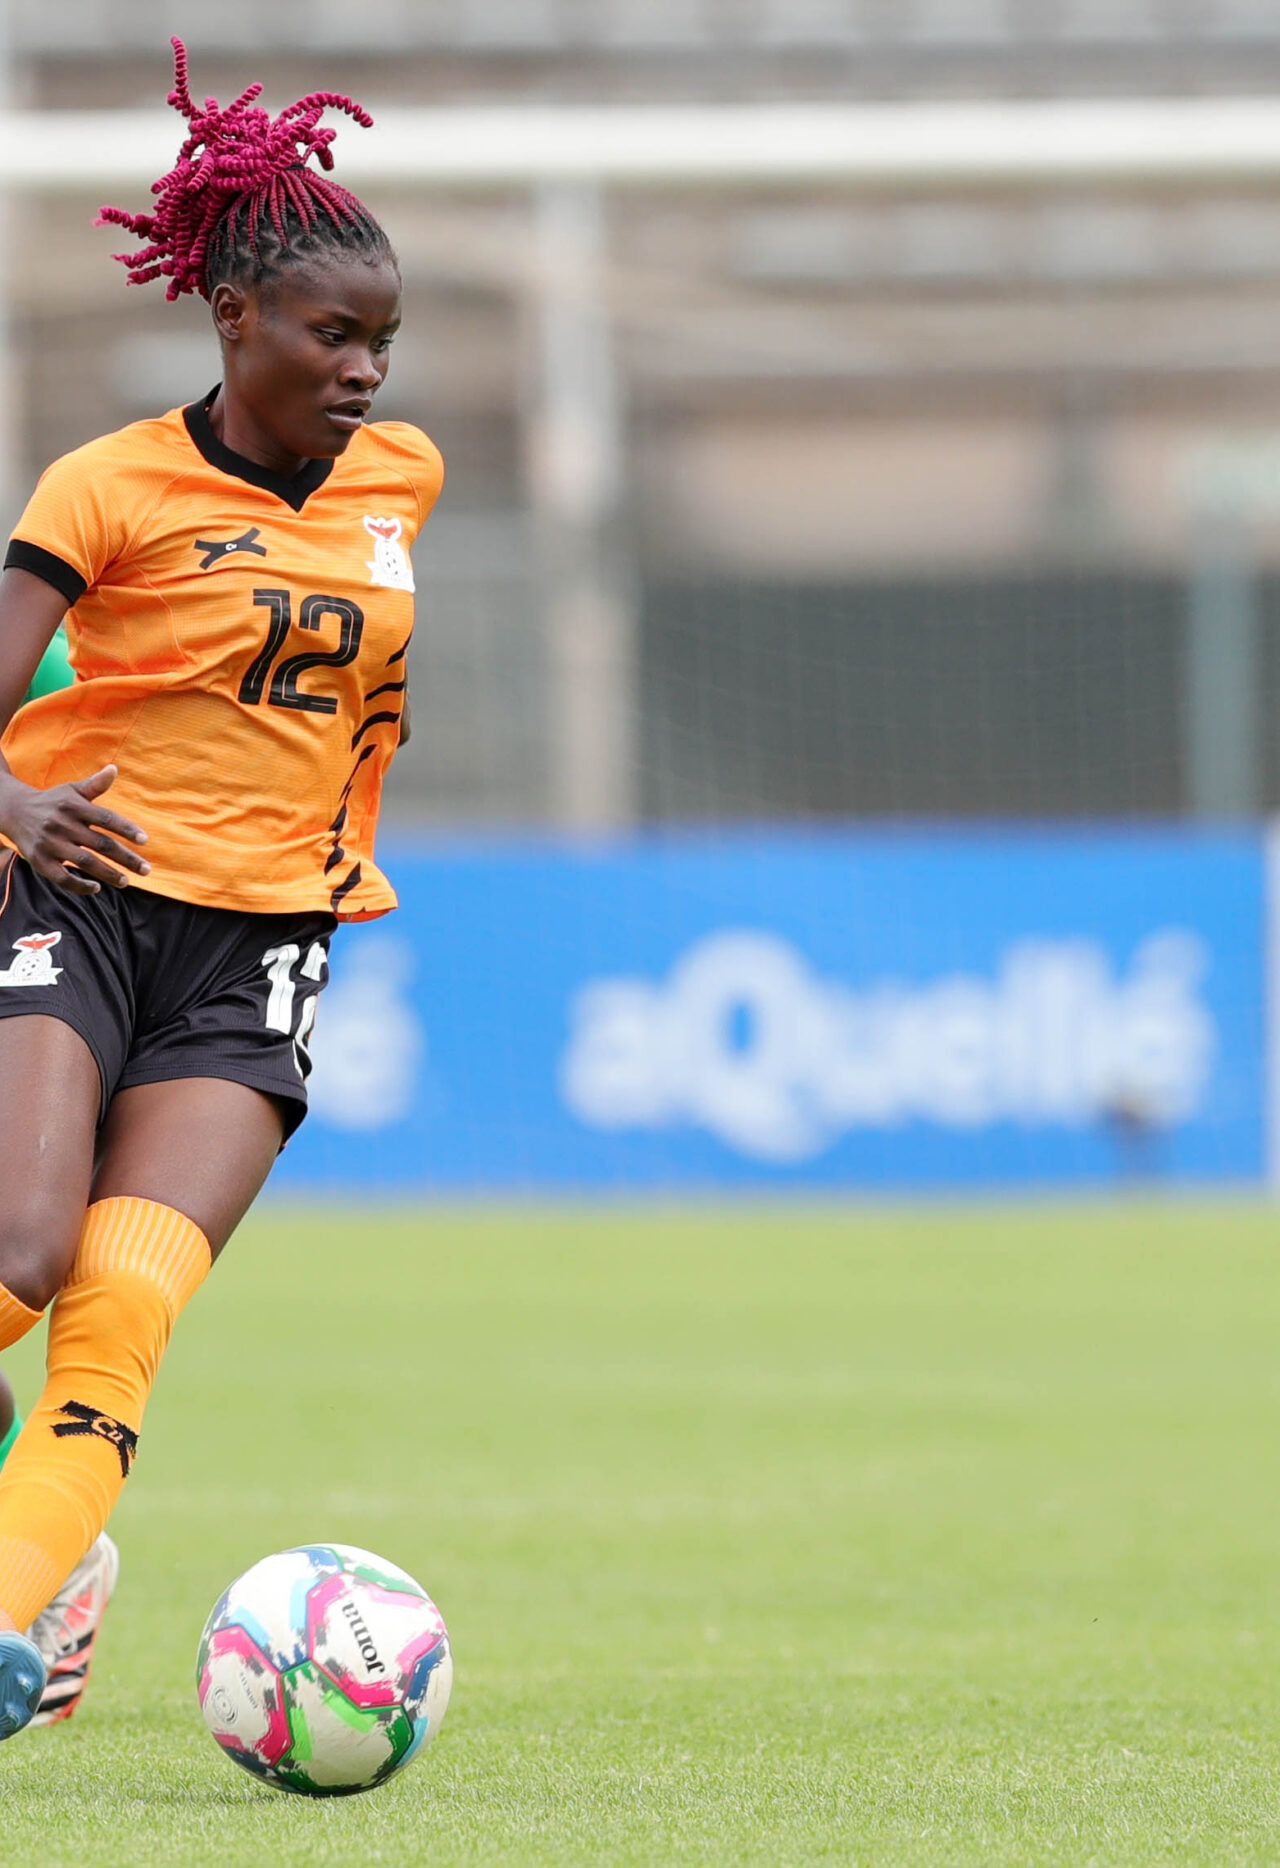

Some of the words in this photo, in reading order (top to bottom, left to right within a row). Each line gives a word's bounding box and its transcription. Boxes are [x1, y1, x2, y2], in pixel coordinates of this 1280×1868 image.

[238, 588, 364, 715] 12
[558, 930, 1213, 1165] aQuellé
[341, 1601, 386, 1674] Joma
